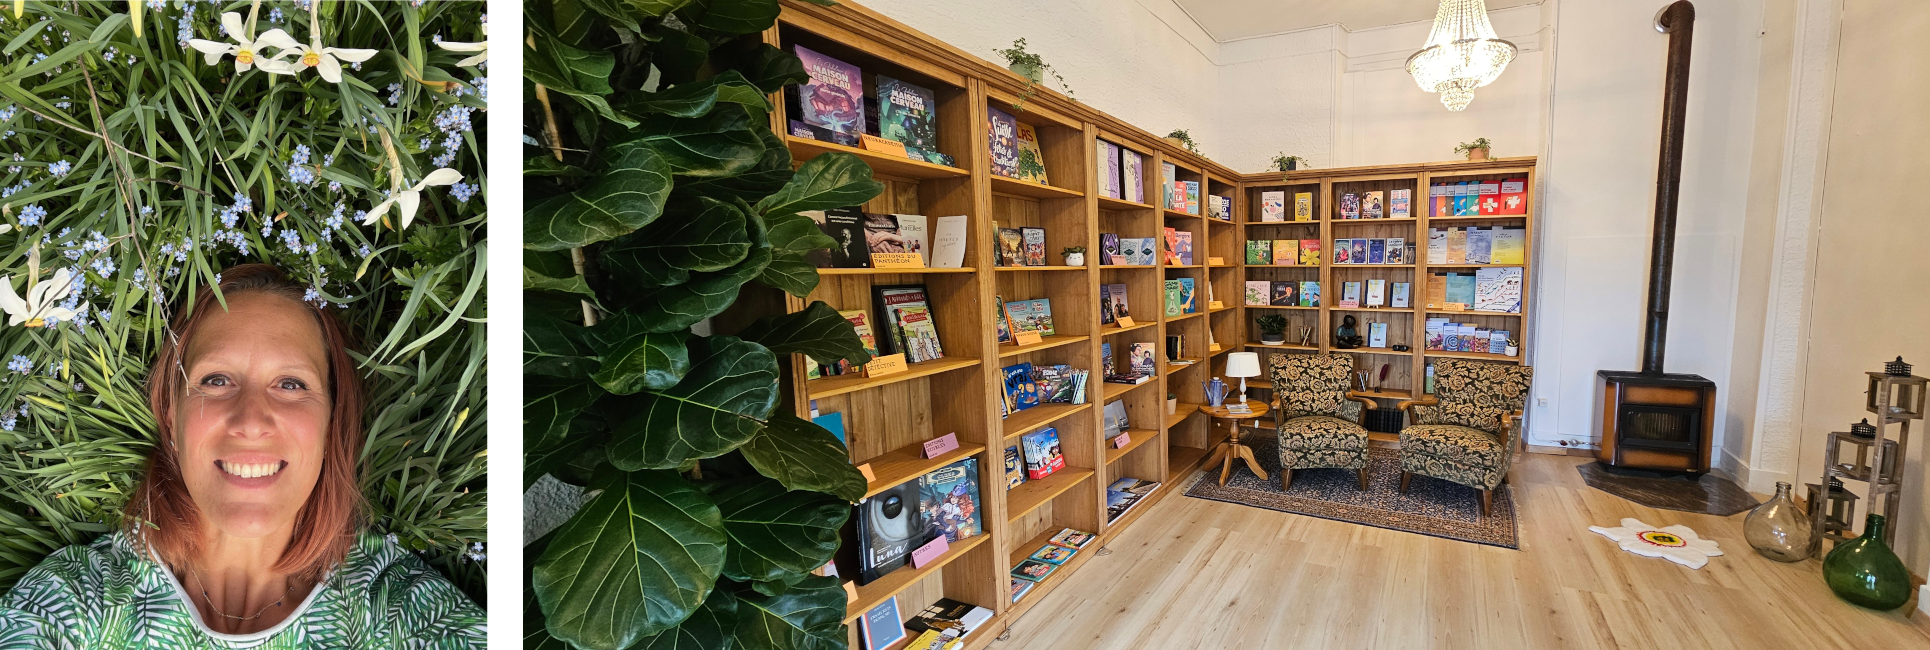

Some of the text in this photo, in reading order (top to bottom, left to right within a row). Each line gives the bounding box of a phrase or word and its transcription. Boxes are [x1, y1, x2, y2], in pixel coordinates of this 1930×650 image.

[811, 71, 851, 90] CERVEAU
[813, 64, 849, 82] MAISON
[890, 96, 925, 111] CERVEAU
[891, 89, 923, 105] MAISON
[1007, 373, 1027, 389] vrai
[870, 542, 908, 569] Luna
